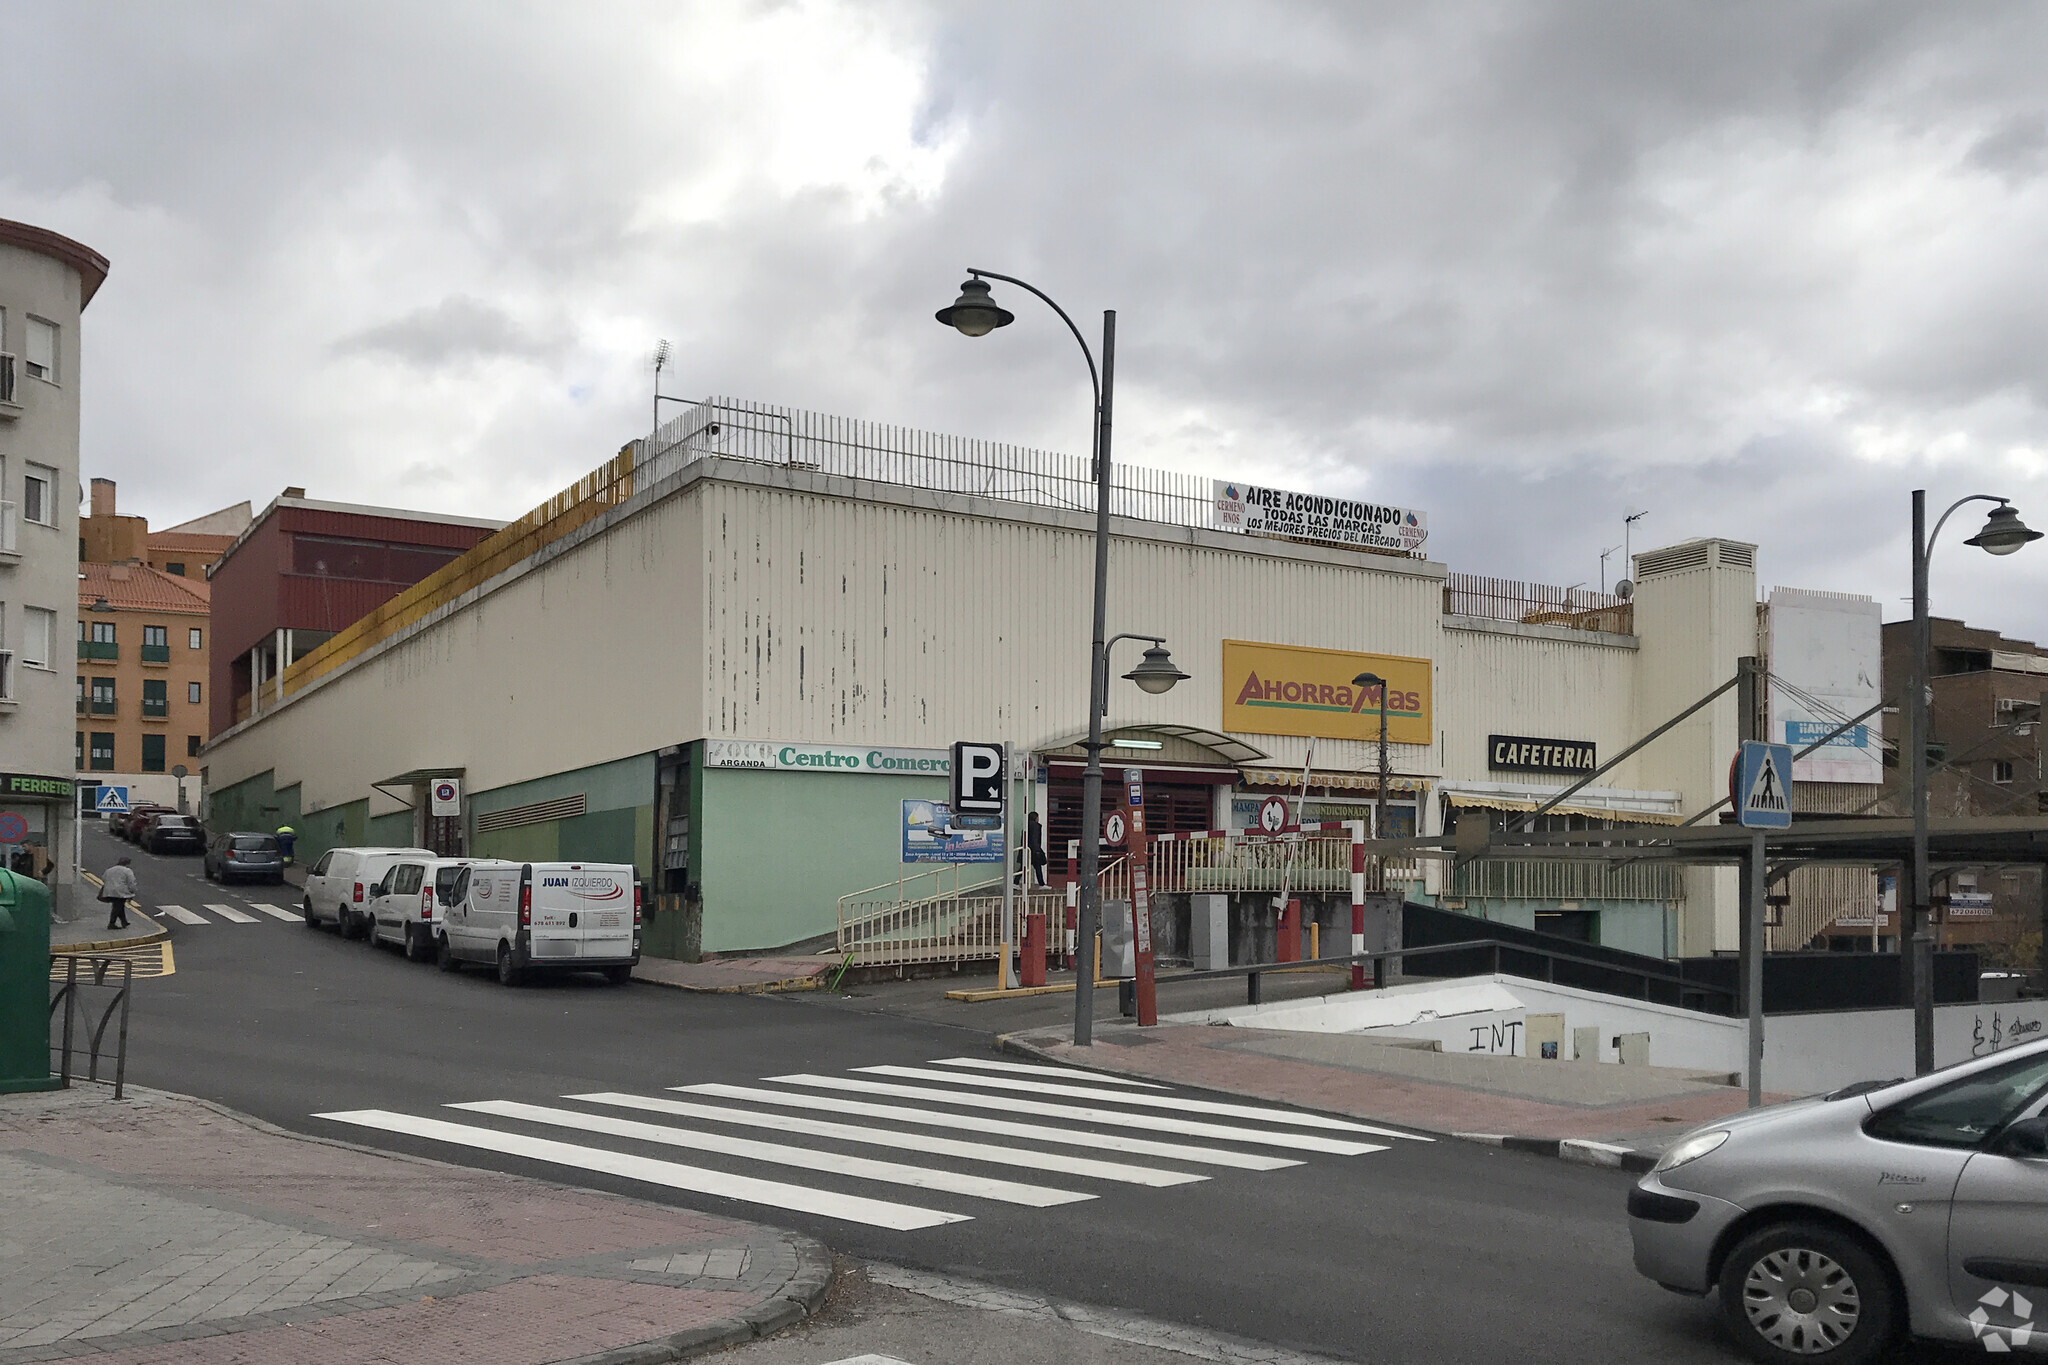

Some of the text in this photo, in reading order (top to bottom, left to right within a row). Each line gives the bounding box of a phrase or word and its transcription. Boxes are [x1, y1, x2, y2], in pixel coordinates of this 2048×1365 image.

[1246, 487, 1401, 526] AIRE ACONDICIONADO
[1247, 518, 1401, 548] LOS MEJORES PRECIOS DEL MERCADO
[1263, 508, 1382, 535] TODAS LAS MARCAS
[720, 759, 766, 768] ARGANDA
[778, 747, 950, 772] Centro Comerc
[1495, 742, 1594, 769] CAFETERIA
[961, 746, 1001, 797] P
[542, 877, 613, 888] JUAN IZQUIERDO
[1469, 1019, 1523, 1056] INT
